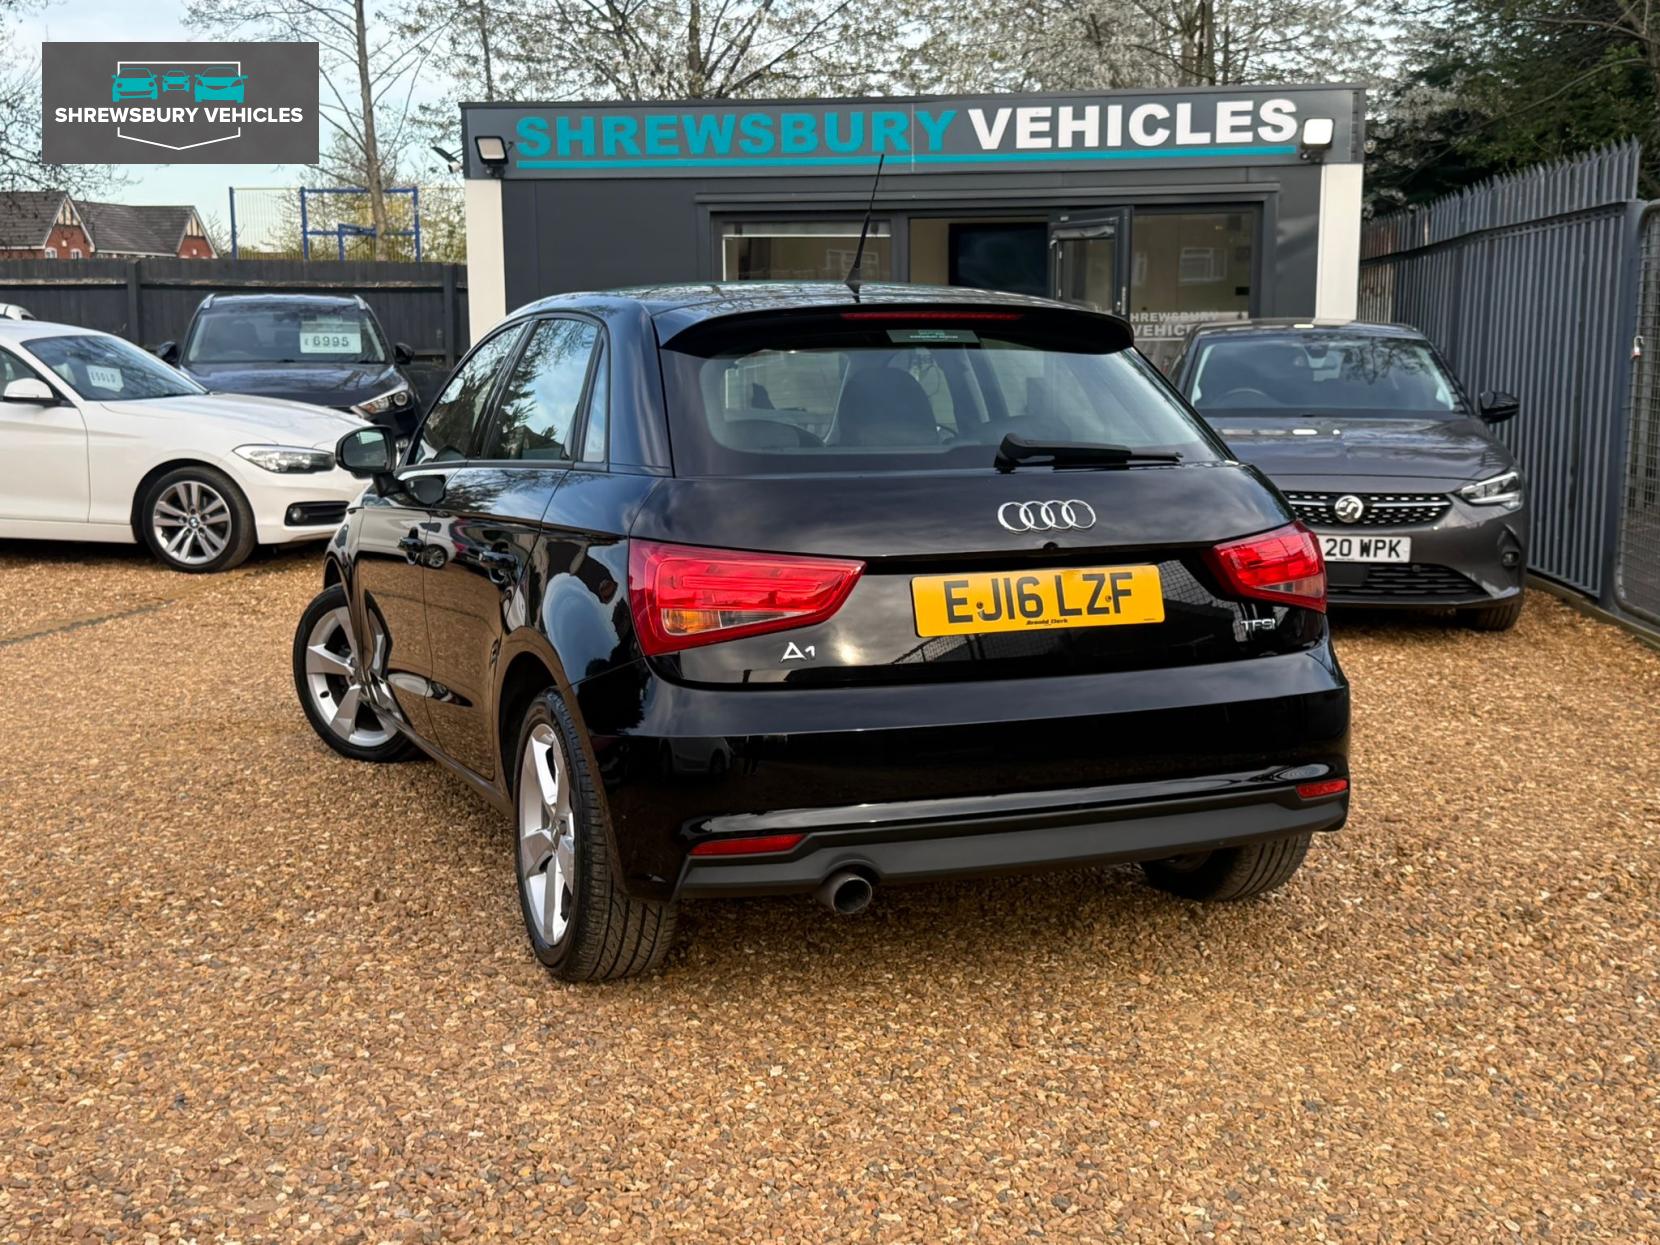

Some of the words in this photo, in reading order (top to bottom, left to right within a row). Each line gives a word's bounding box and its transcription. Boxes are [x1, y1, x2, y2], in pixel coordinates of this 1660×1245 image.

[515, 109, 958, 157] SHREWSBURY
[968, 98, 1298, 150] VEHICLES
[1130, 312, 1217, 322] HREWSBURY
[1132, 324, 1191, 337] VEHIC
[1324, 538, 1352, 557] 20
[1360, 539, 1401, 558] WPK
[943, 576, 1044, 624] EJ16
[1055, 572, 1133, 617] LZF
[1240, 618, 1275, 631] TFSI
[780, 641, 816, 662] A1
